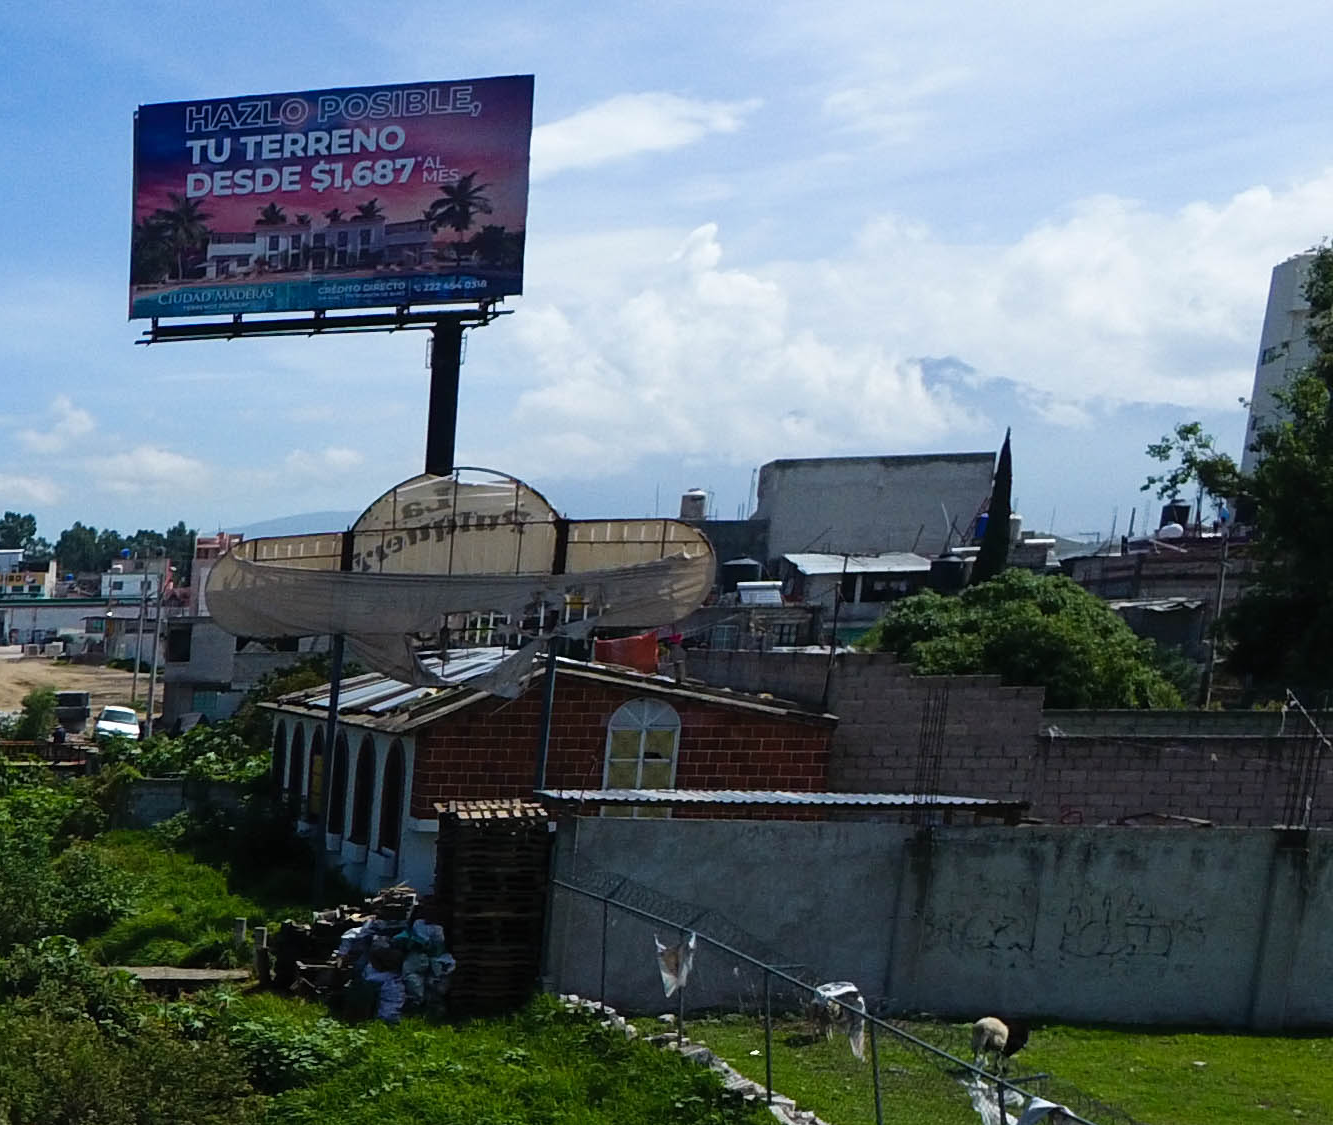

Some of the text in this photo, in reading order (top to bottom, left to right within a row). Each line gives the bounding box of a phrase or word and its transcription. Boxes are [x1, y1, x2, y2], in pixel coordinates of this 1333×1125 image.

[186, 86, 481, 132] HAZLO POSIBLE,
[186, 125, 405, 164] TU TERRENO
[422, 156, 445, 169] AL
[186, 166, 302, 198] DESDE
[423, 168, 460, 183] MES
[157, 286, 275, 305] CIUDAD MADERAS
